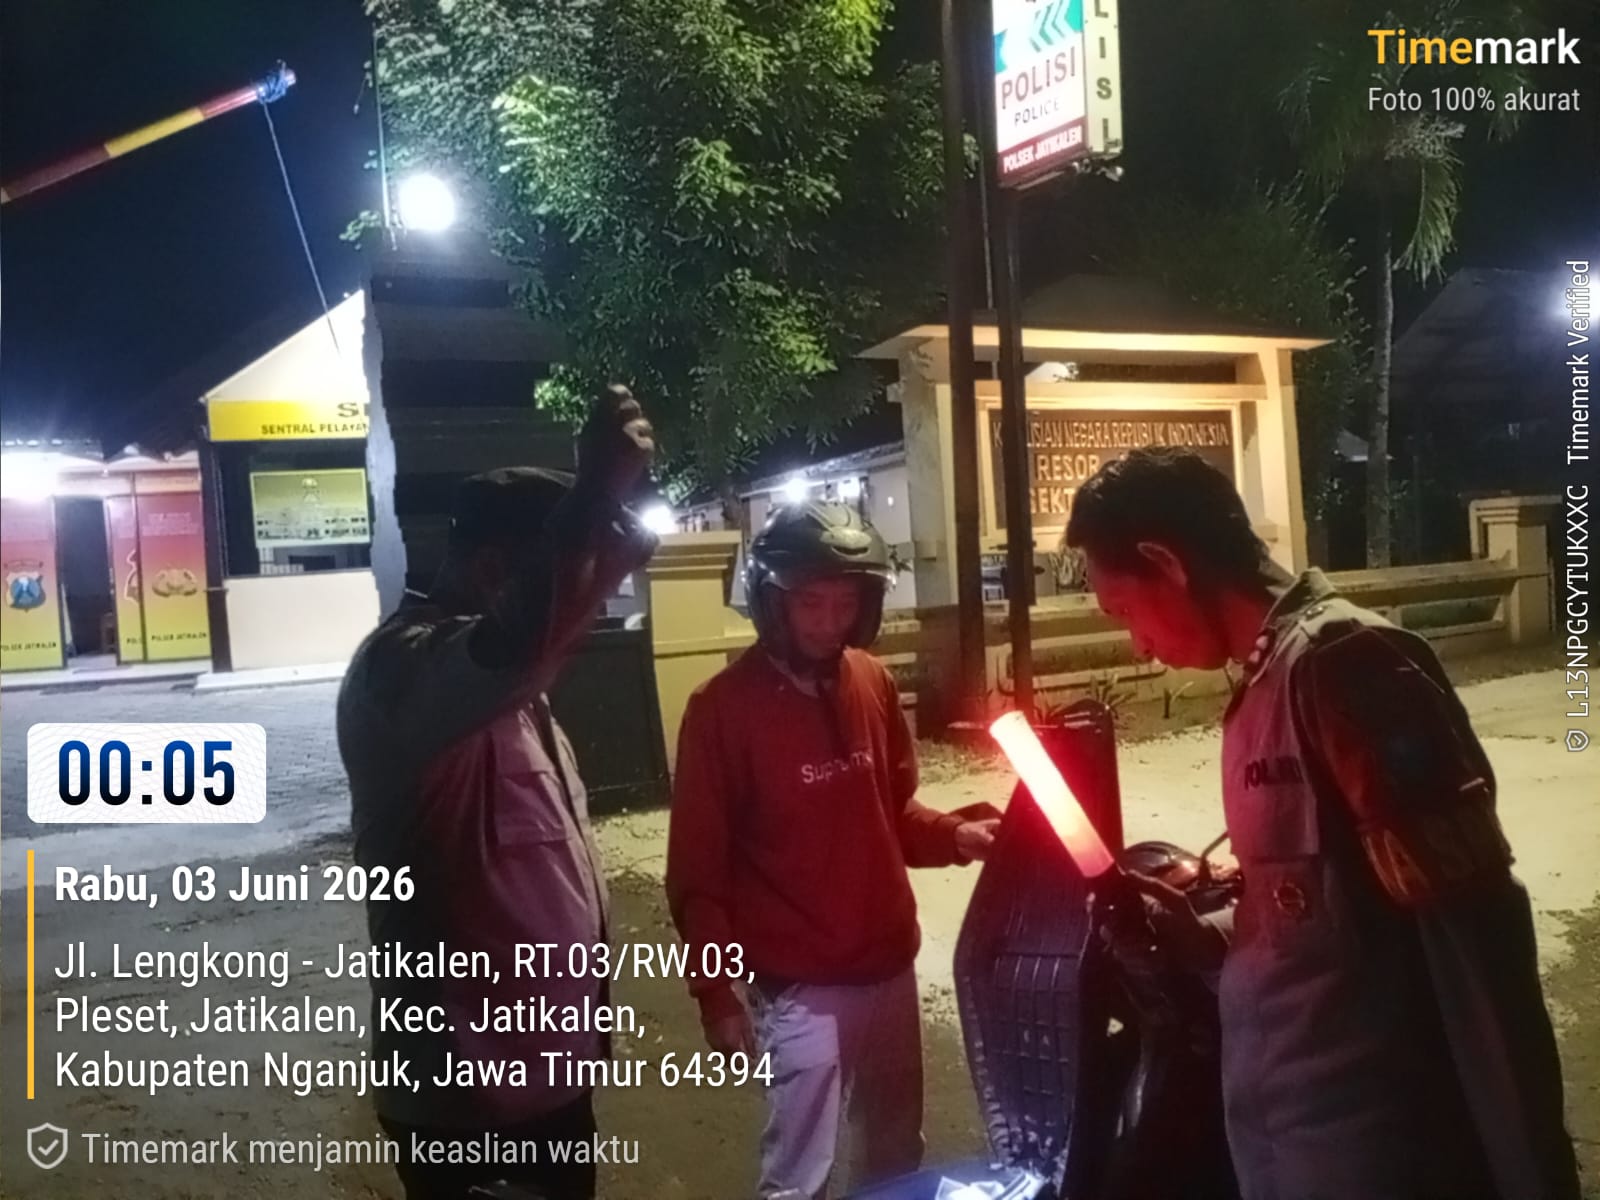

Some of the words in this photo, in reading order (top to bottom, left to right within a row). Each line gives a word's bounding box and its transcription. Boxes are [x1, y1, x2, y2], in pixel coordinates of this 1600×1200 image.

[1001, 46, 1076, 110] POLISI
[1013, 97, 1060, 127] POLICE
[1003, 144, 1034, 174] POLSEK
[261, 423, 316, 436] SENTRAL
[993, 421, 1063, 448] KLISIAN
[1064, 421, 1112, 448] NEGARA
[1112, 421, 1167, 448] REPUBLIK
[1167, 421, 1230, 447] INDONESIA
[1036, 453, 1101, 481] RESOR
